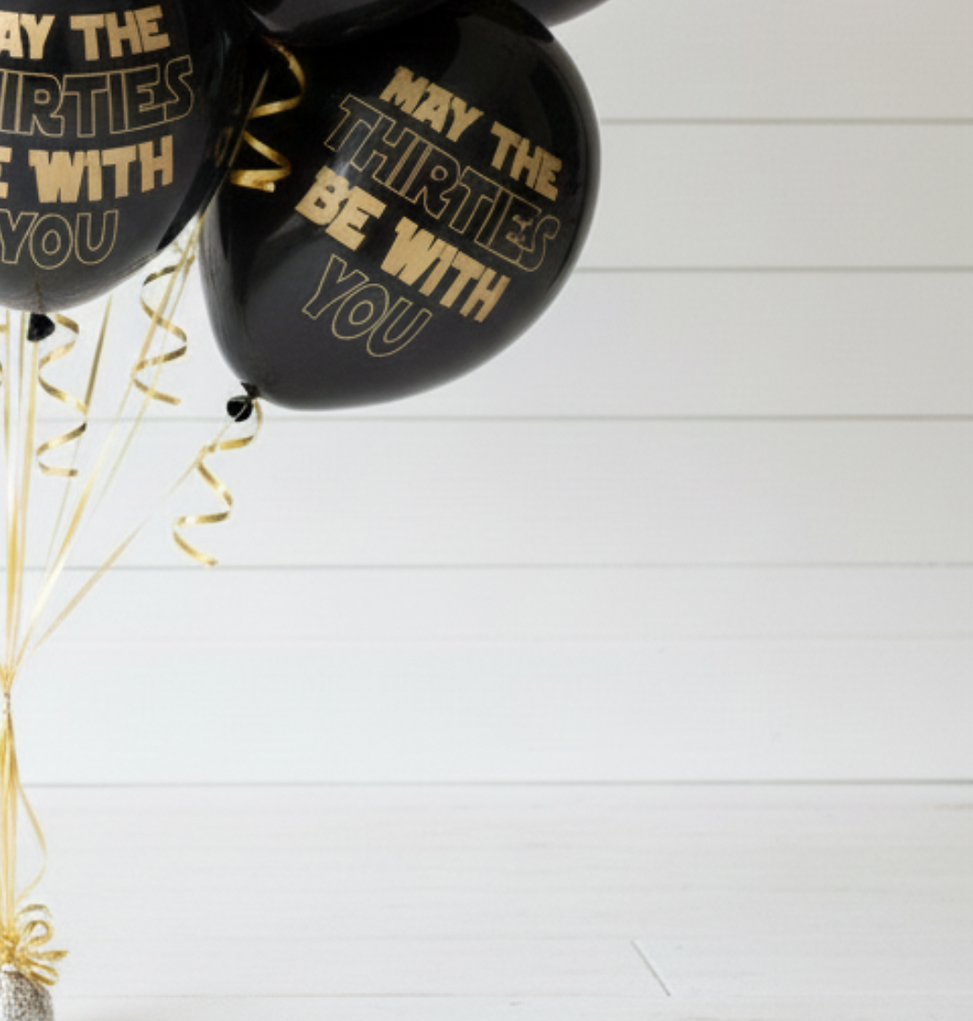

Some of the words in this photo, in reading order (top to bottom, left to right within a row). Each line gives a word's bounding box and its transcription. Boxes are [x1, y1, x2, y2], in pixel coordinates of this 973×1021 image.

[70, 4, 170, 61] THE
[28, 135, 173, 203] WITH
[324, 93, 560, 272] THIRTIES
[379, 65, 484, 143] MAY
[490, 121, 562, 201] THE
[295, 165, 387, 252] BE
[380, 216, 511, 323] WITH
[302, 253, 432, 358] YOU
